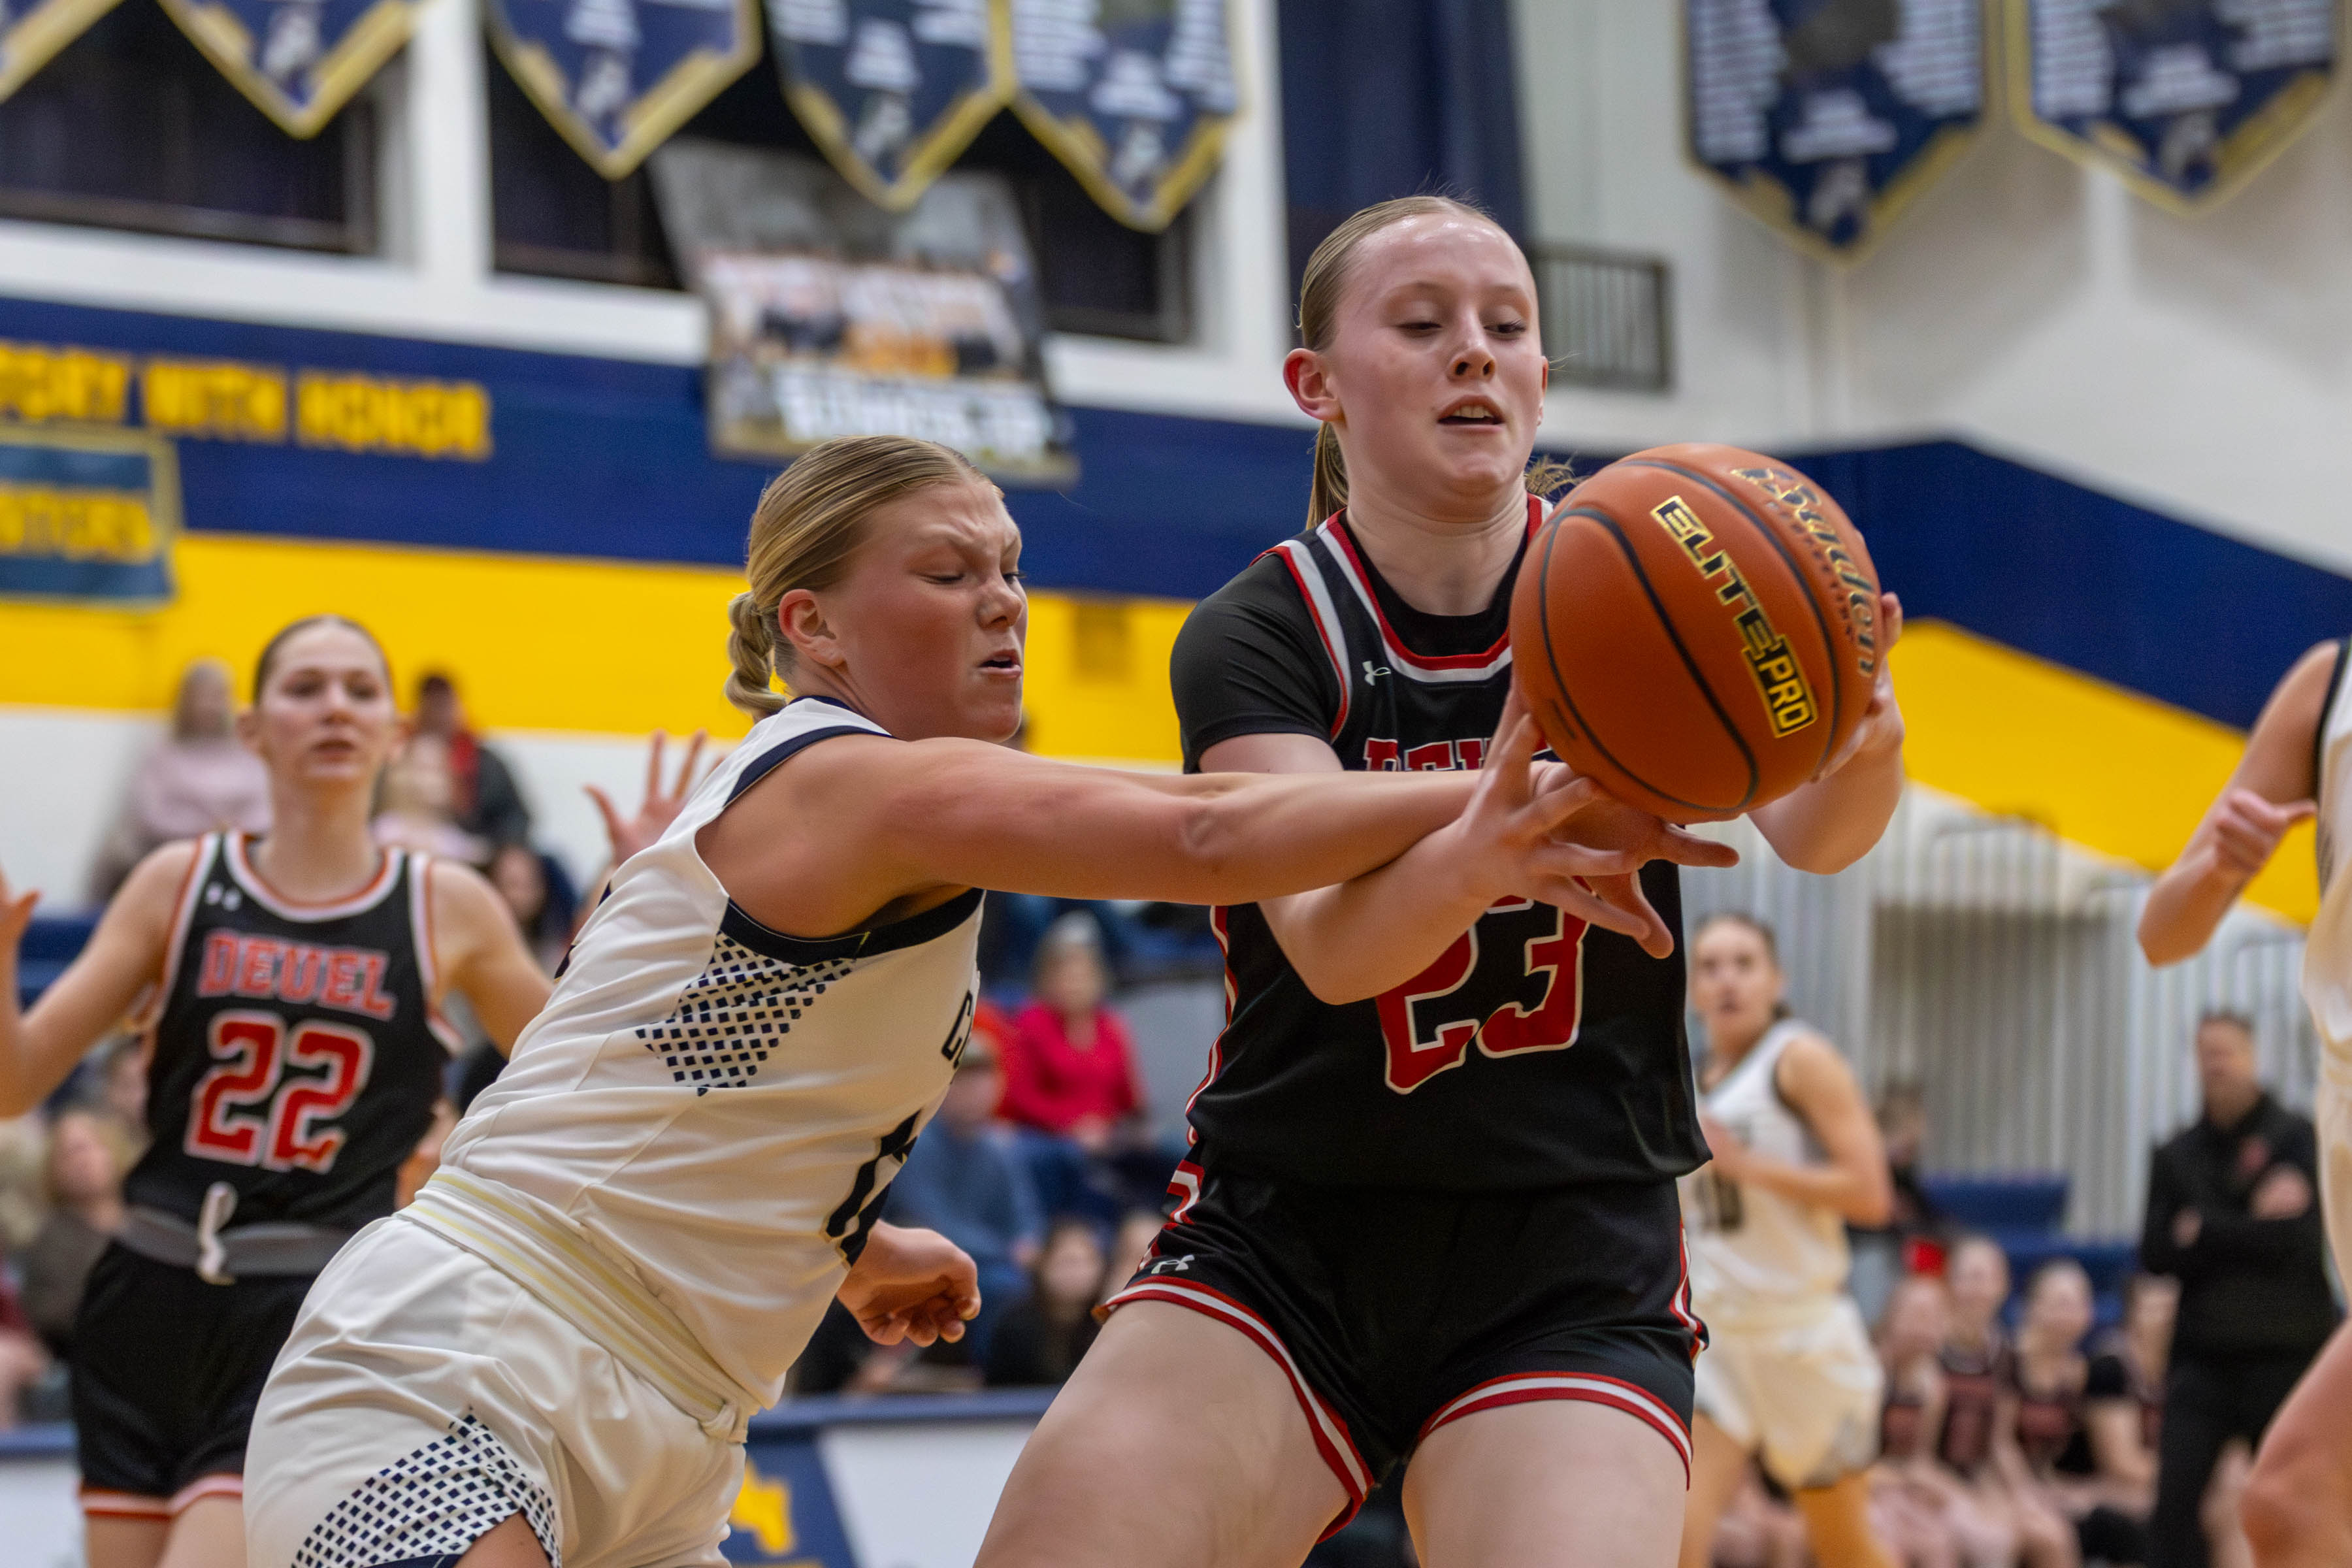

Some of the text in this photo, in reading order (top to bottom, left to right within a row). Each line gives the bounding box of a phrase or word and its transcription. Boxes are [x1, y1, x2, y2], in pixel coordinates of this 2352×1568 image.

[1650, 495, 1784, 660] ELITE
[1756, 653, 1811, 736] PRO
[199, 929, 395, 1021] DEUEL
[184, 1009, 375, 1173] 22
